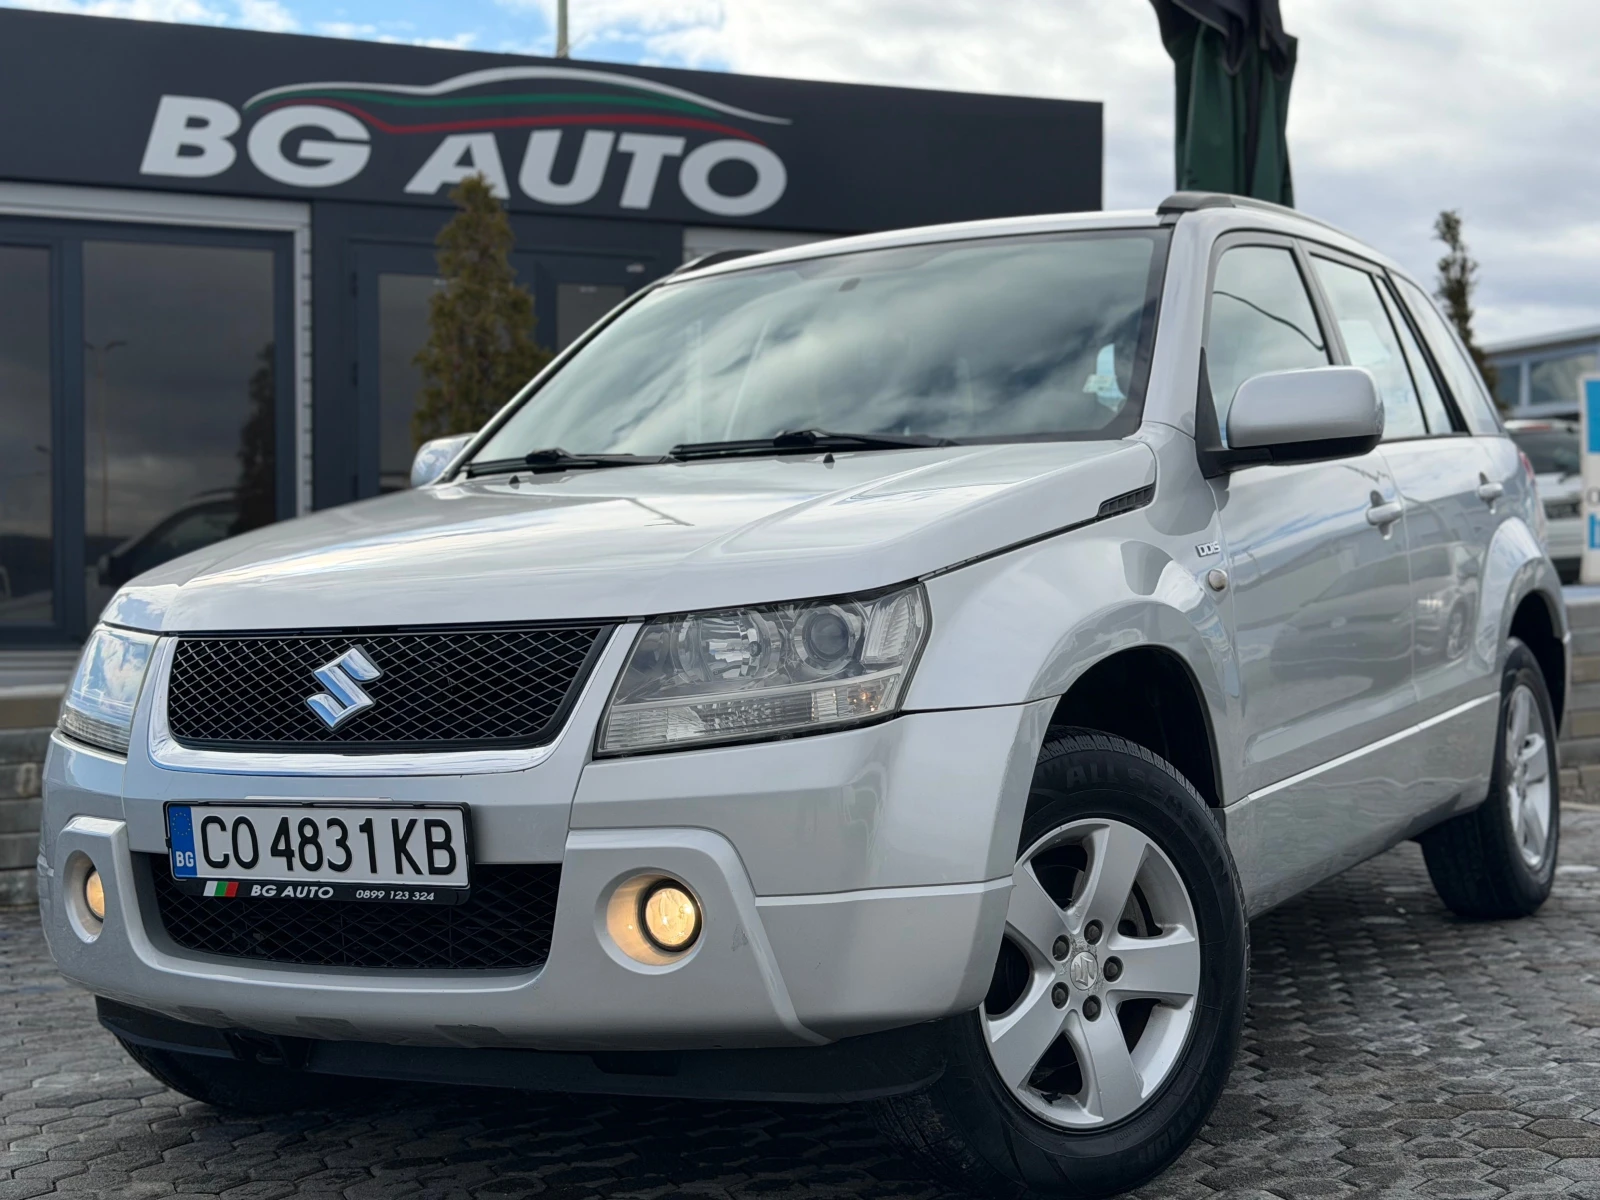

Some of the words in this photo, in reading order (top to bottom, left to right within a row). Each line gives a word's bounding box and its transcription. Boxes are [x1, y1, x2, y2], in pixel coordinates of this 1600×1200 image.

[140, 95, 371, 188] BG
[403, 129, 787, 217] AUTO
[175, 850, 194, 868] BG
[200, 814, 260, 870] CO
[269, 815, 378, 875] 4831
[390, 817, 457, 876] KB
[250, 884, 277, 898] BG
[281, 885, 334, 899] AUTO
[355, 888, 385, 900] 0899
[388, 889, 410, 901] 123
[411, 890, 435, 902] 324
